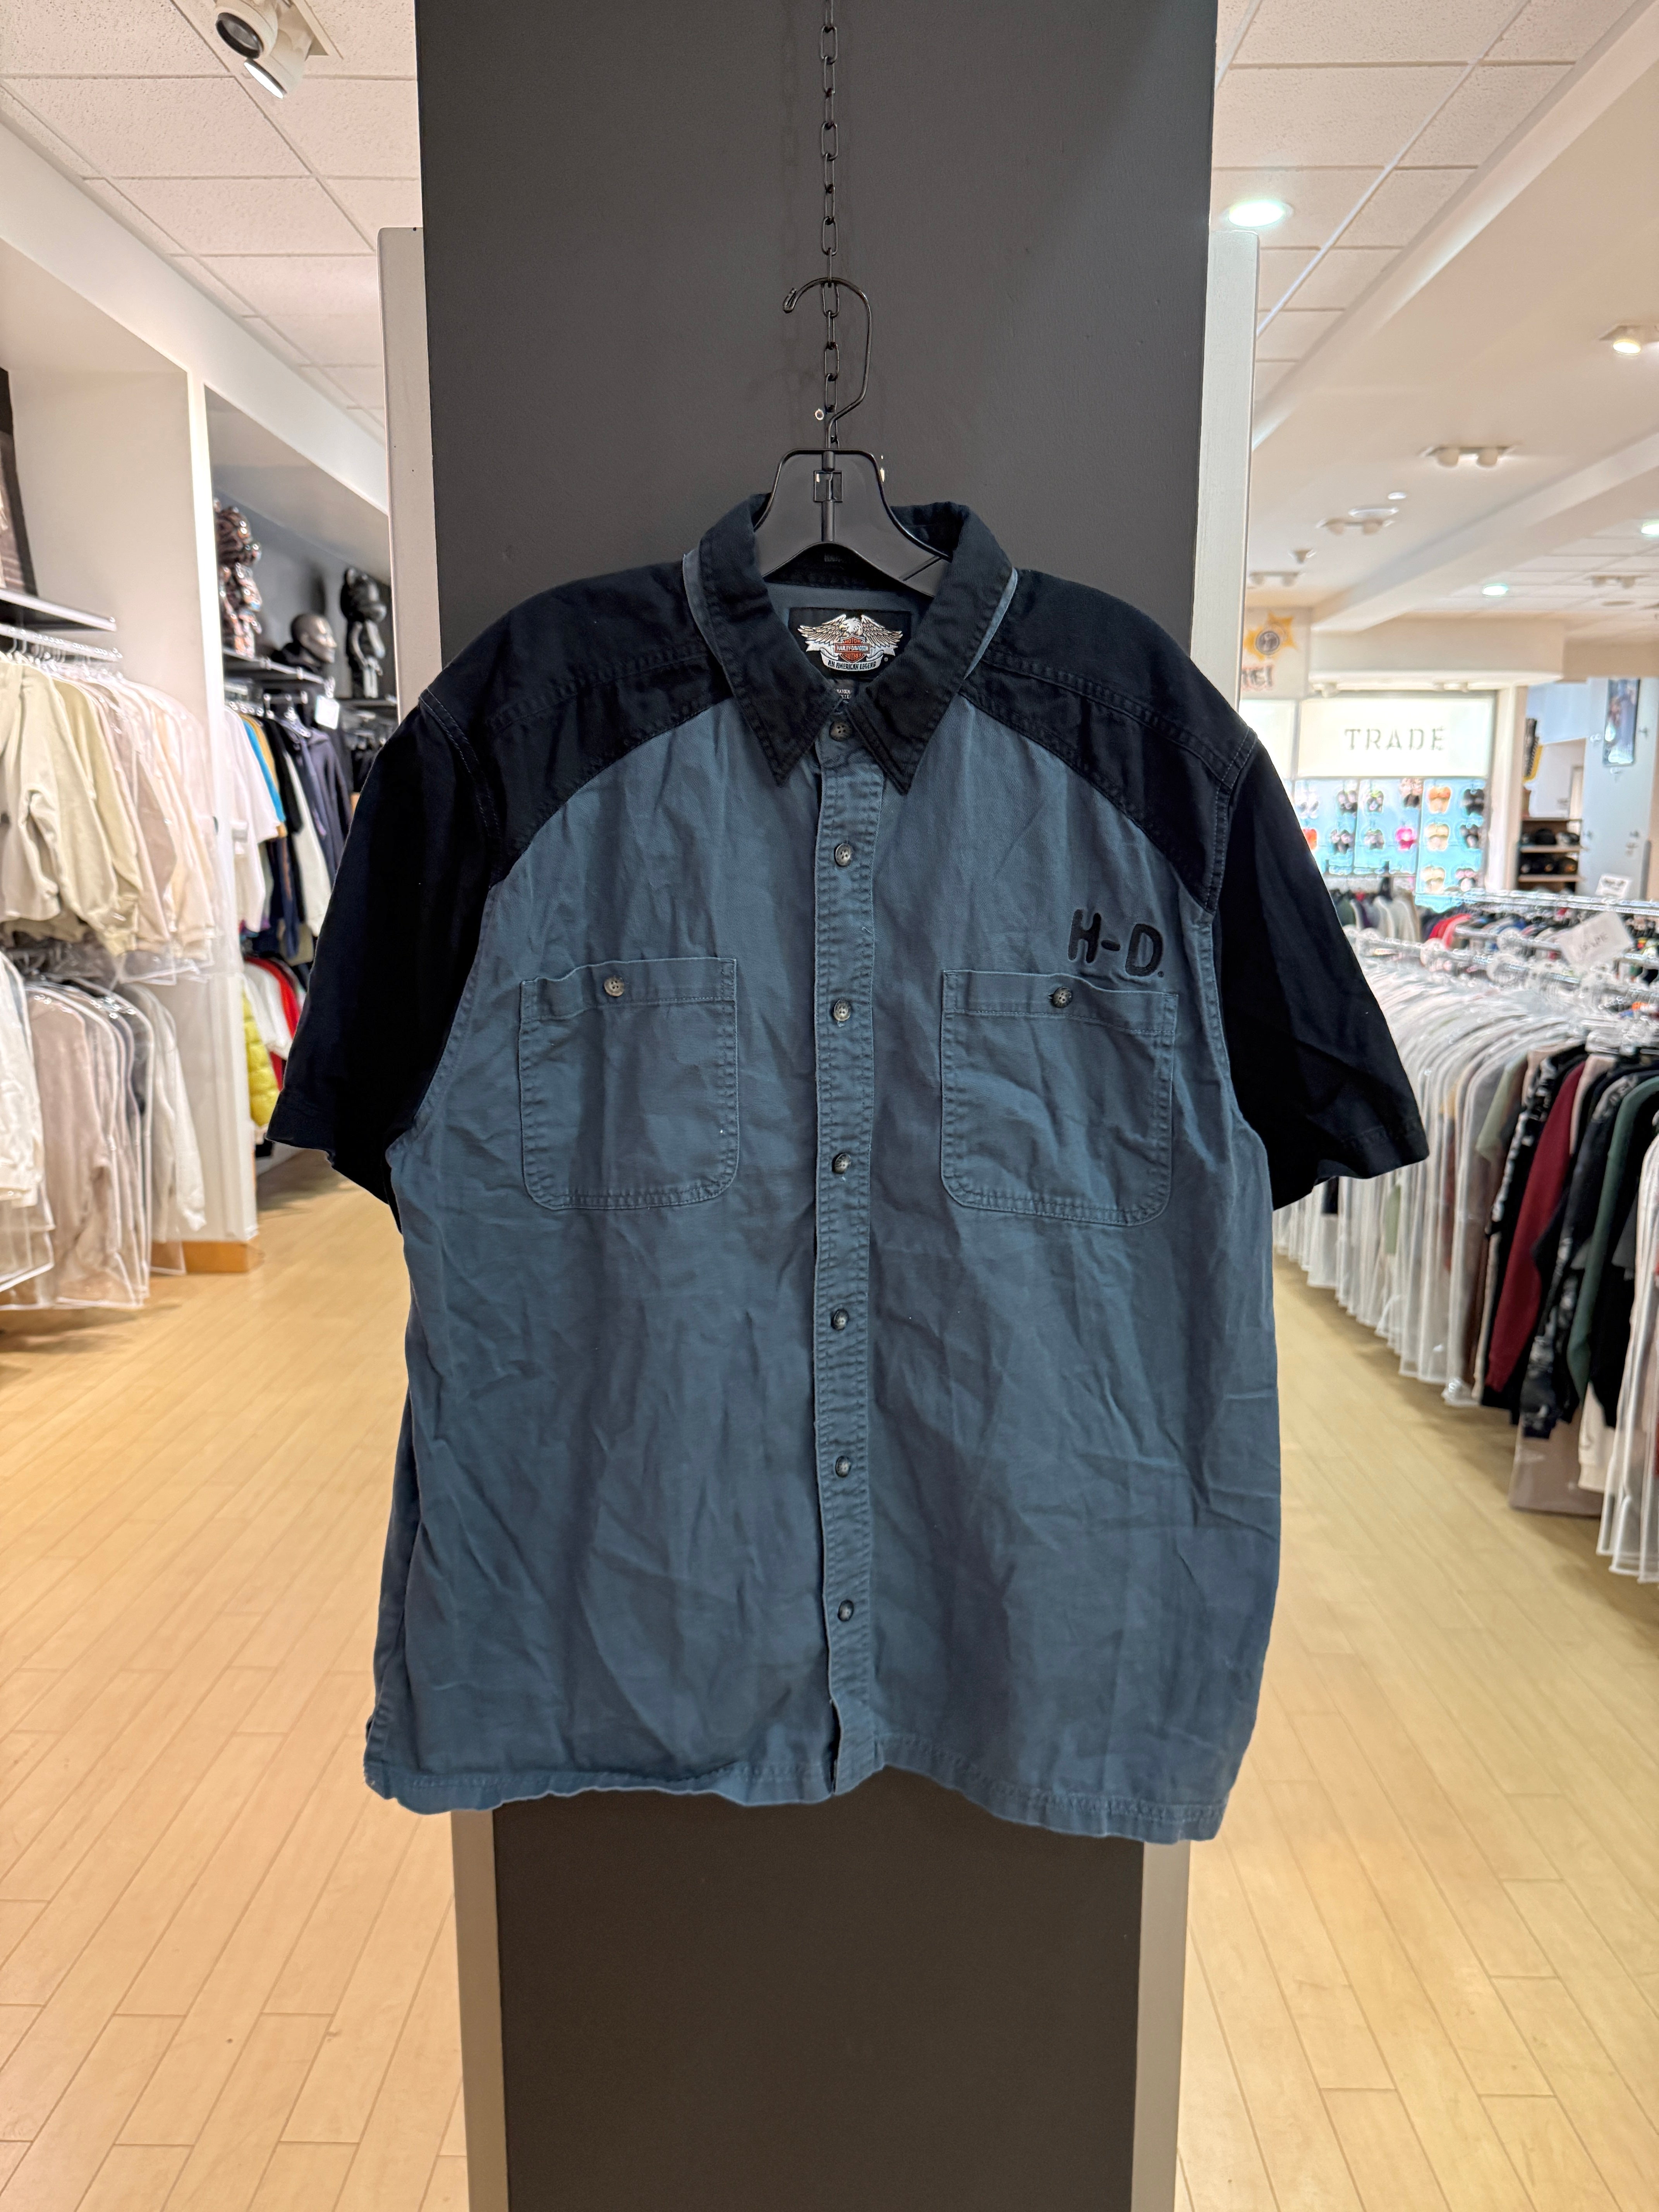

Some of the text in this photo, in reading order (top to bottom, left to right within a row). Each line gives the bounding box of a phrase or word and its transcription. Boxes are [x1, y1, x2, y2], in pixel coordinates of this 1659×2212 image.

[836, 662, 859, 670] AMERICAN
[860, 661, 876, 670] LEGEND
[1344, 726, 1445, 750] TRADE
